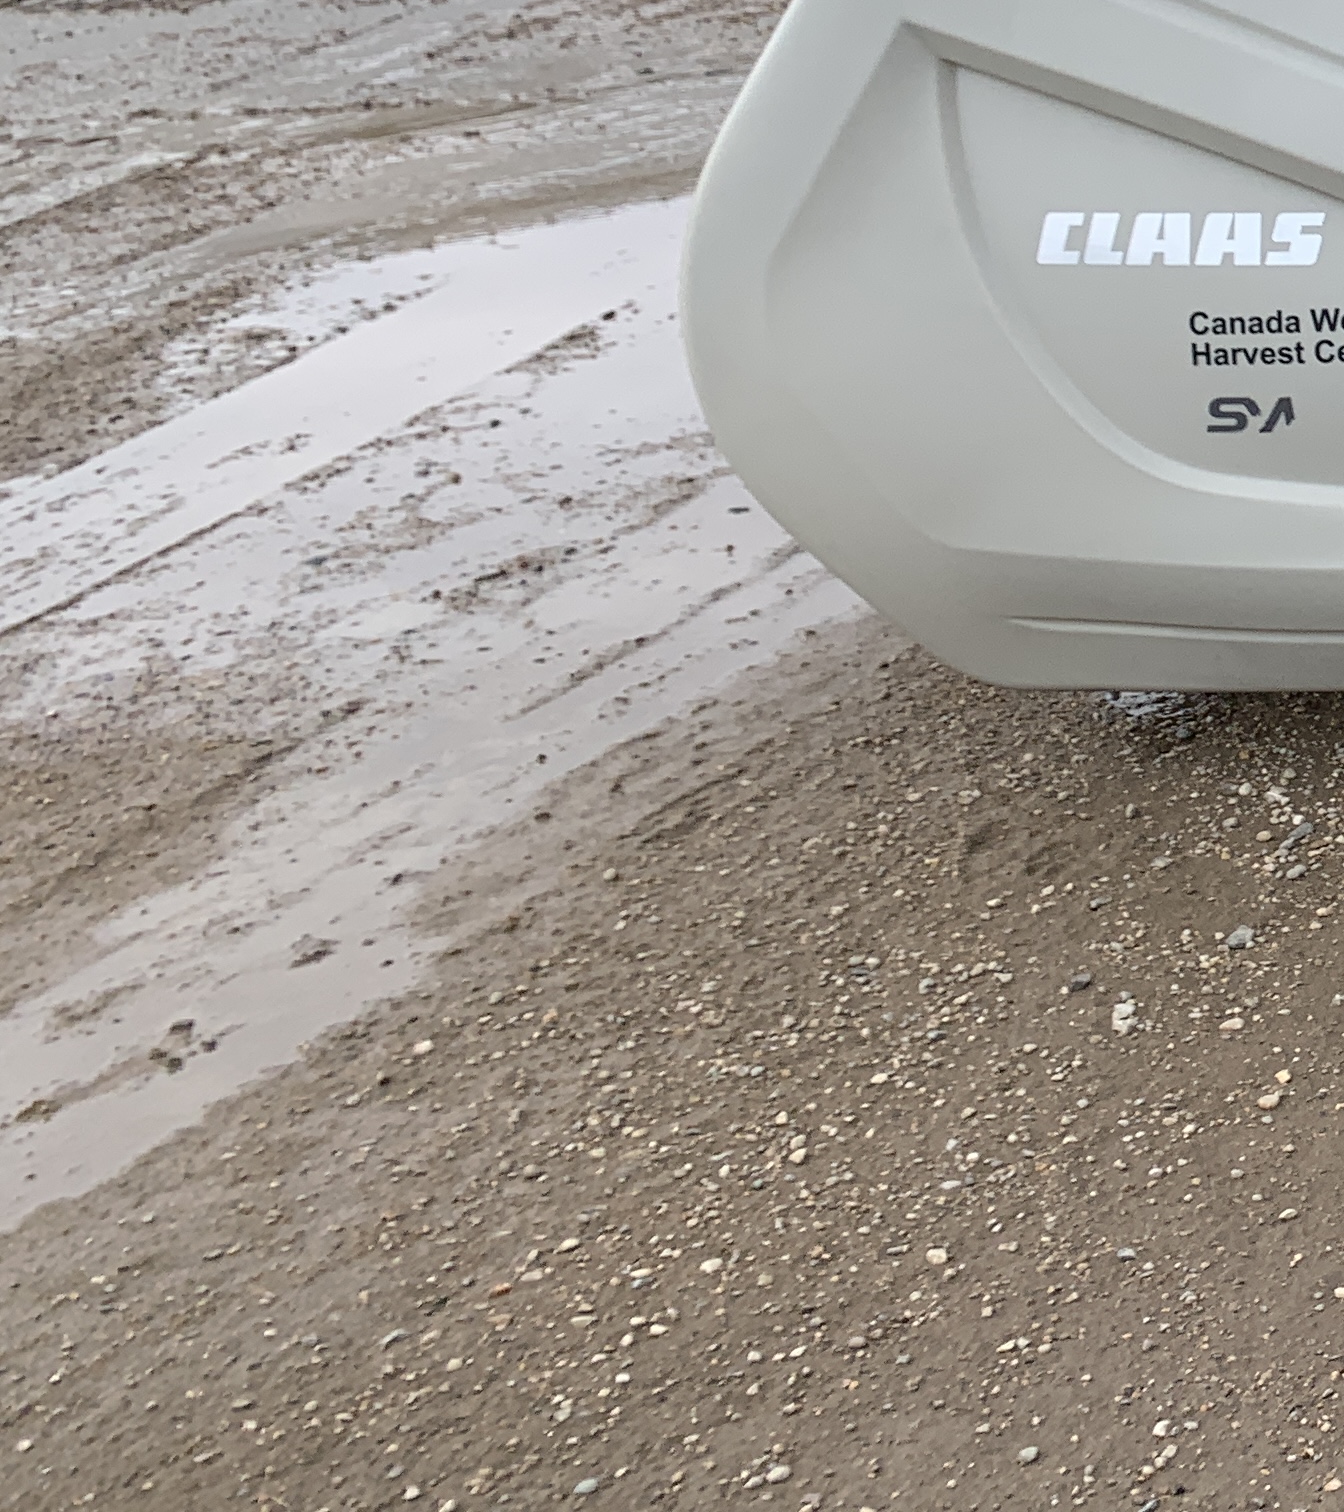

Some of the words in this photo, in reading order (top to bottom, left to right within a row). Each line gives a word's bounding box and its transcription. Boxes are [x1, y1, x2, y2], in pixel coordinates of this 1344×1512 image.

[1036, 212, 1326, 266] CLAAS
[1189, 309, 1301, 336] Canada
[1191, 341, 1306, 366] Harvest
